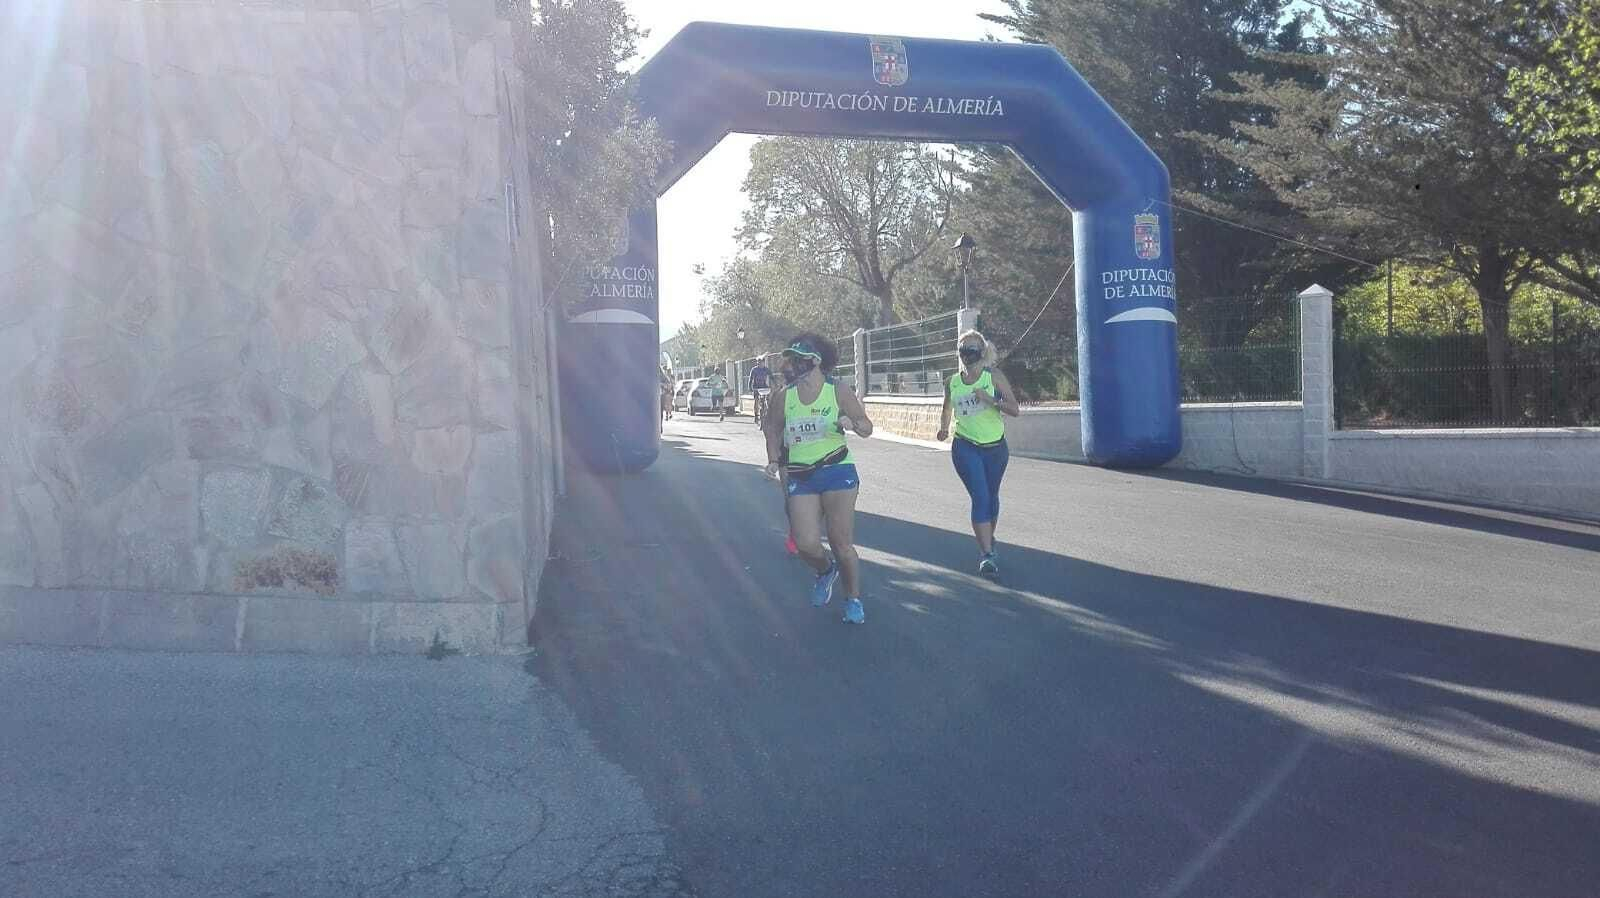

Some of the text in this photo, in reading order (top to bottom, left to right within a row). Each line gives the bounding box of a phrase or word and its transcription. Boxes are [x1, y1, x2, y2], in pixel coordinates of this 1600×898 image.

[766, 91, 1005, 116] DIPUTACIÓN DE ALMERÍA
[590, 282, 655, 299] ALMERÍA
[1104, 285, 1125, 300] DE
[798, 423, 817, 433] 101
